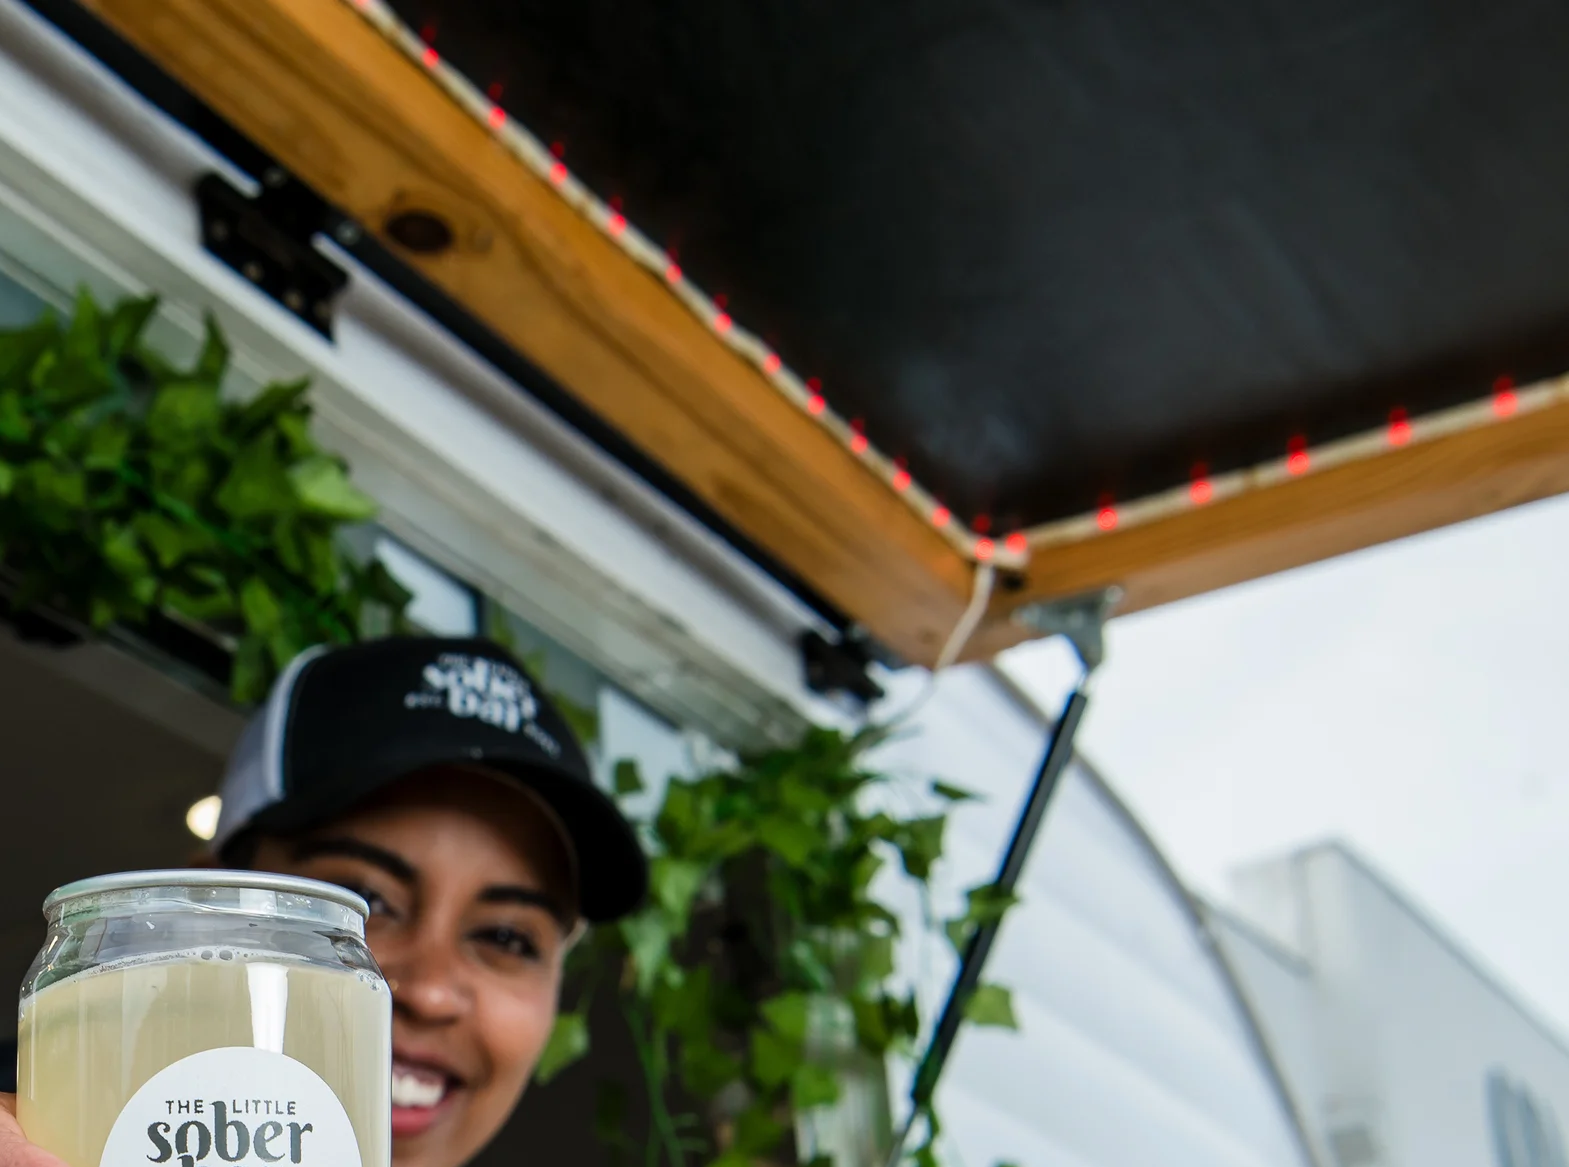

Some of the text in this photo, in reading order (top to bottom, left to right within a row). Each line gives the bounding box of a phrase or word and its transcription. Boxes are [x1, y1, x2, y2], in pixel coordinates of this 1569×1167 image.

[165, 1099, 297, 1116] THE LITTLE
[146, 1100, 314, 1164] sober
